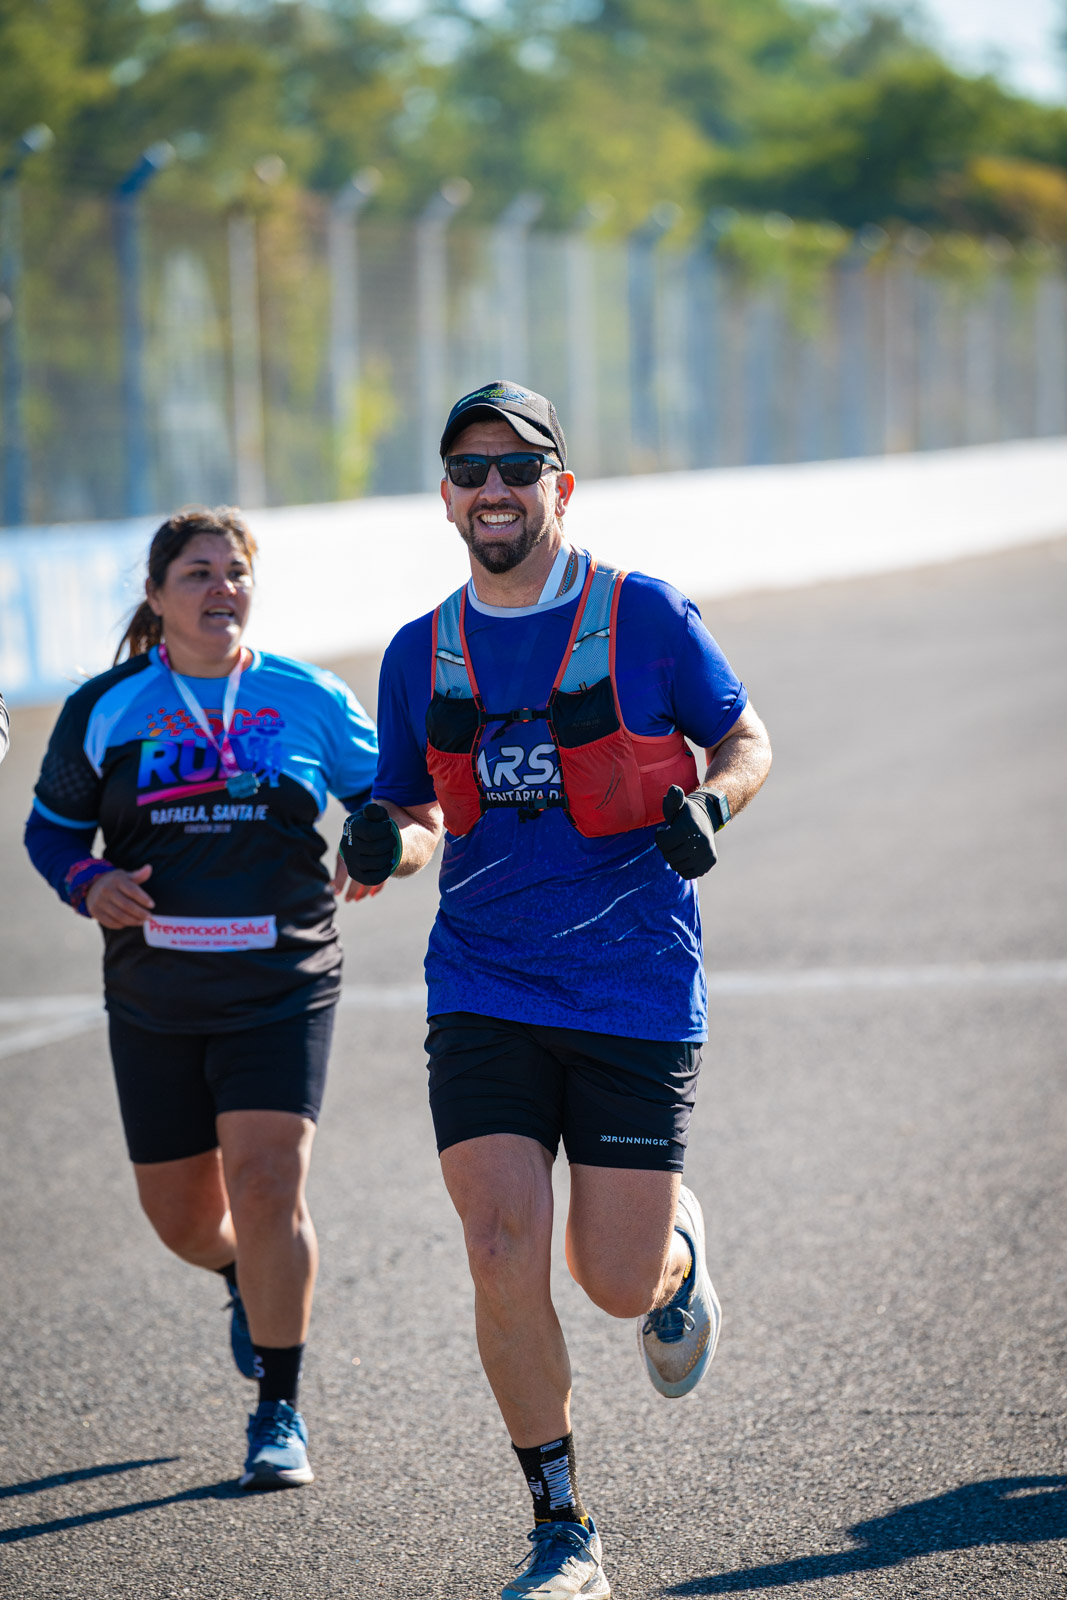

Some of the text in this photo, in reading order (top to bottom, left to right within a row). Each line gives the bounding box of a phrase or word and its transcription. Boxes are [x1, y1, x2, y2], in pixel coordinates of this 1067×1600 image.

[150, 805, 210, 824] RAFAELA,
[212, 804, 253, 821] SANTA
[230, 920, 269, 936] Salud
[611, 1135, 658, 1146] RUNNING
